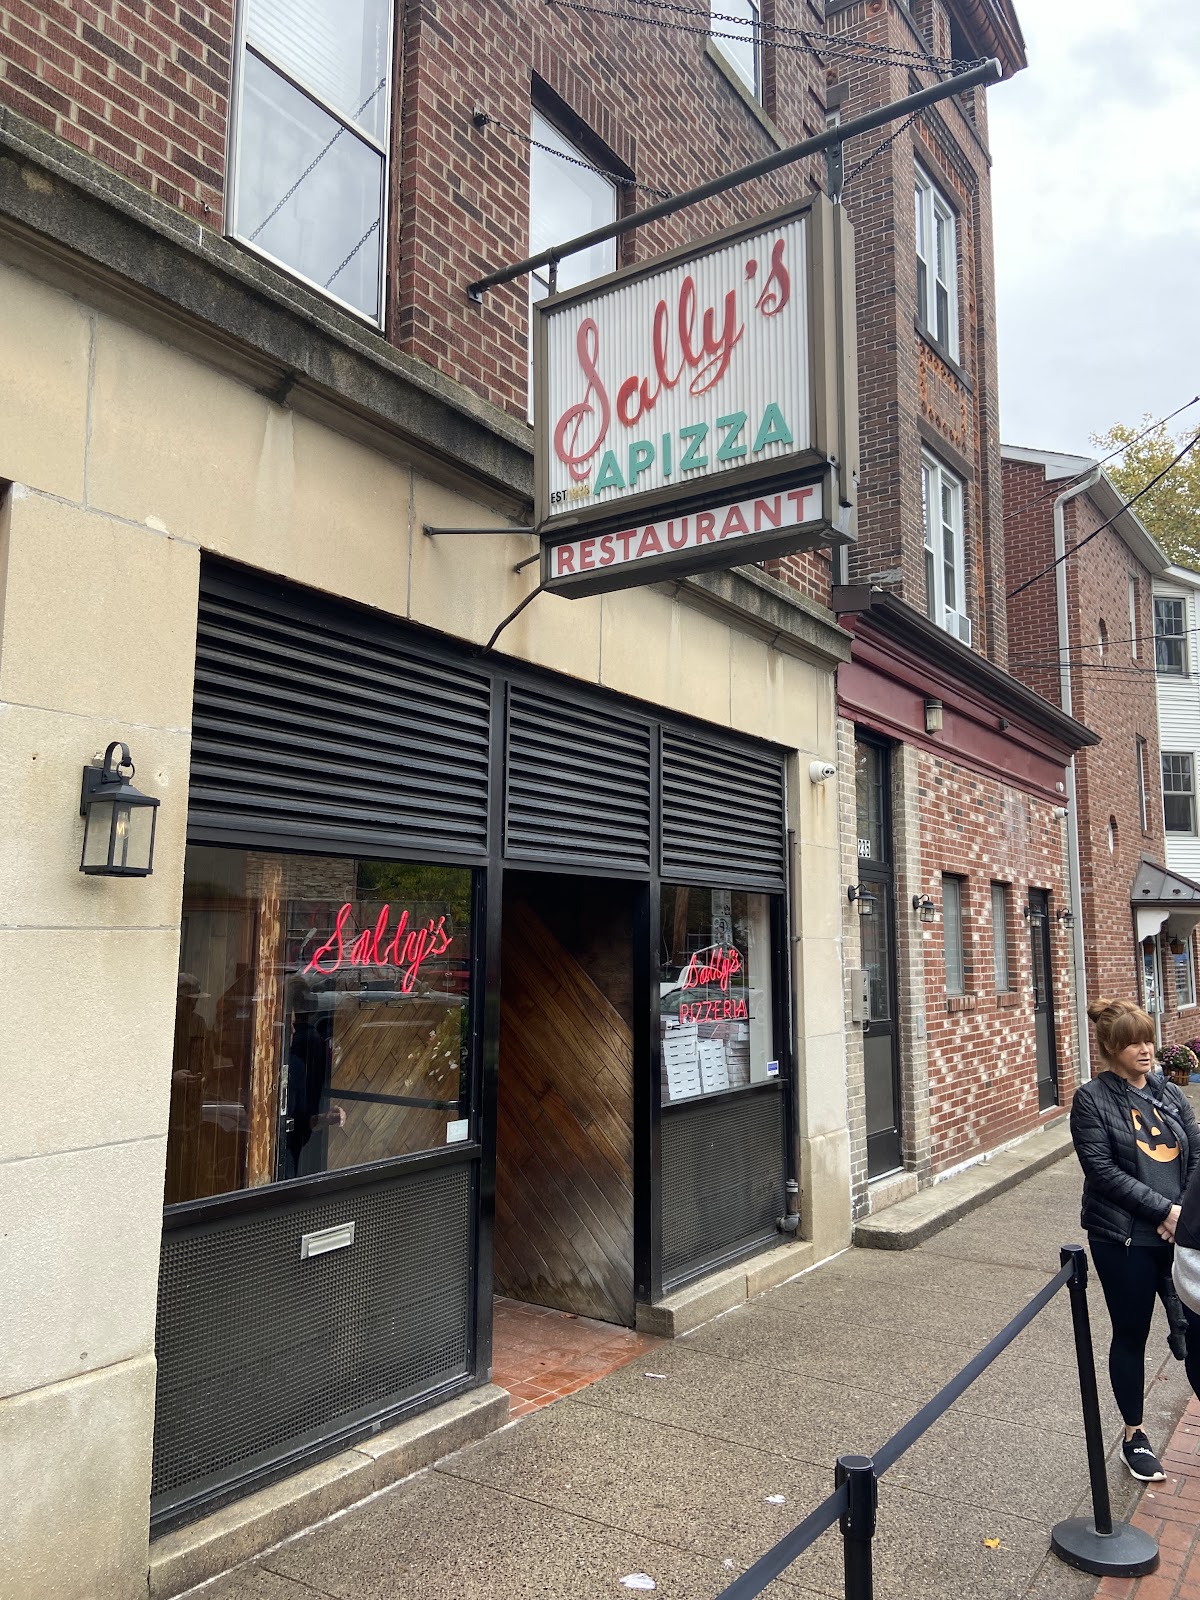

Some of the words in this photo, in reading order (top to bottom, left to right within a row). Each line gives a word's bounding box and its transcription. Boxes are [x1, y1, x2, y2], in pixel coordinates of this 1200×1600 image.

[554, 239, 791, 481] Sally's
[593, 402, 794, 495] APIZZA
[557, 488, 814, 575] RESTAURANT
[303, 902, 453, 993] Sally's
[682, 947, 743, 991] Sally's
[680, 998, 748, 1024] PIZZERIA
